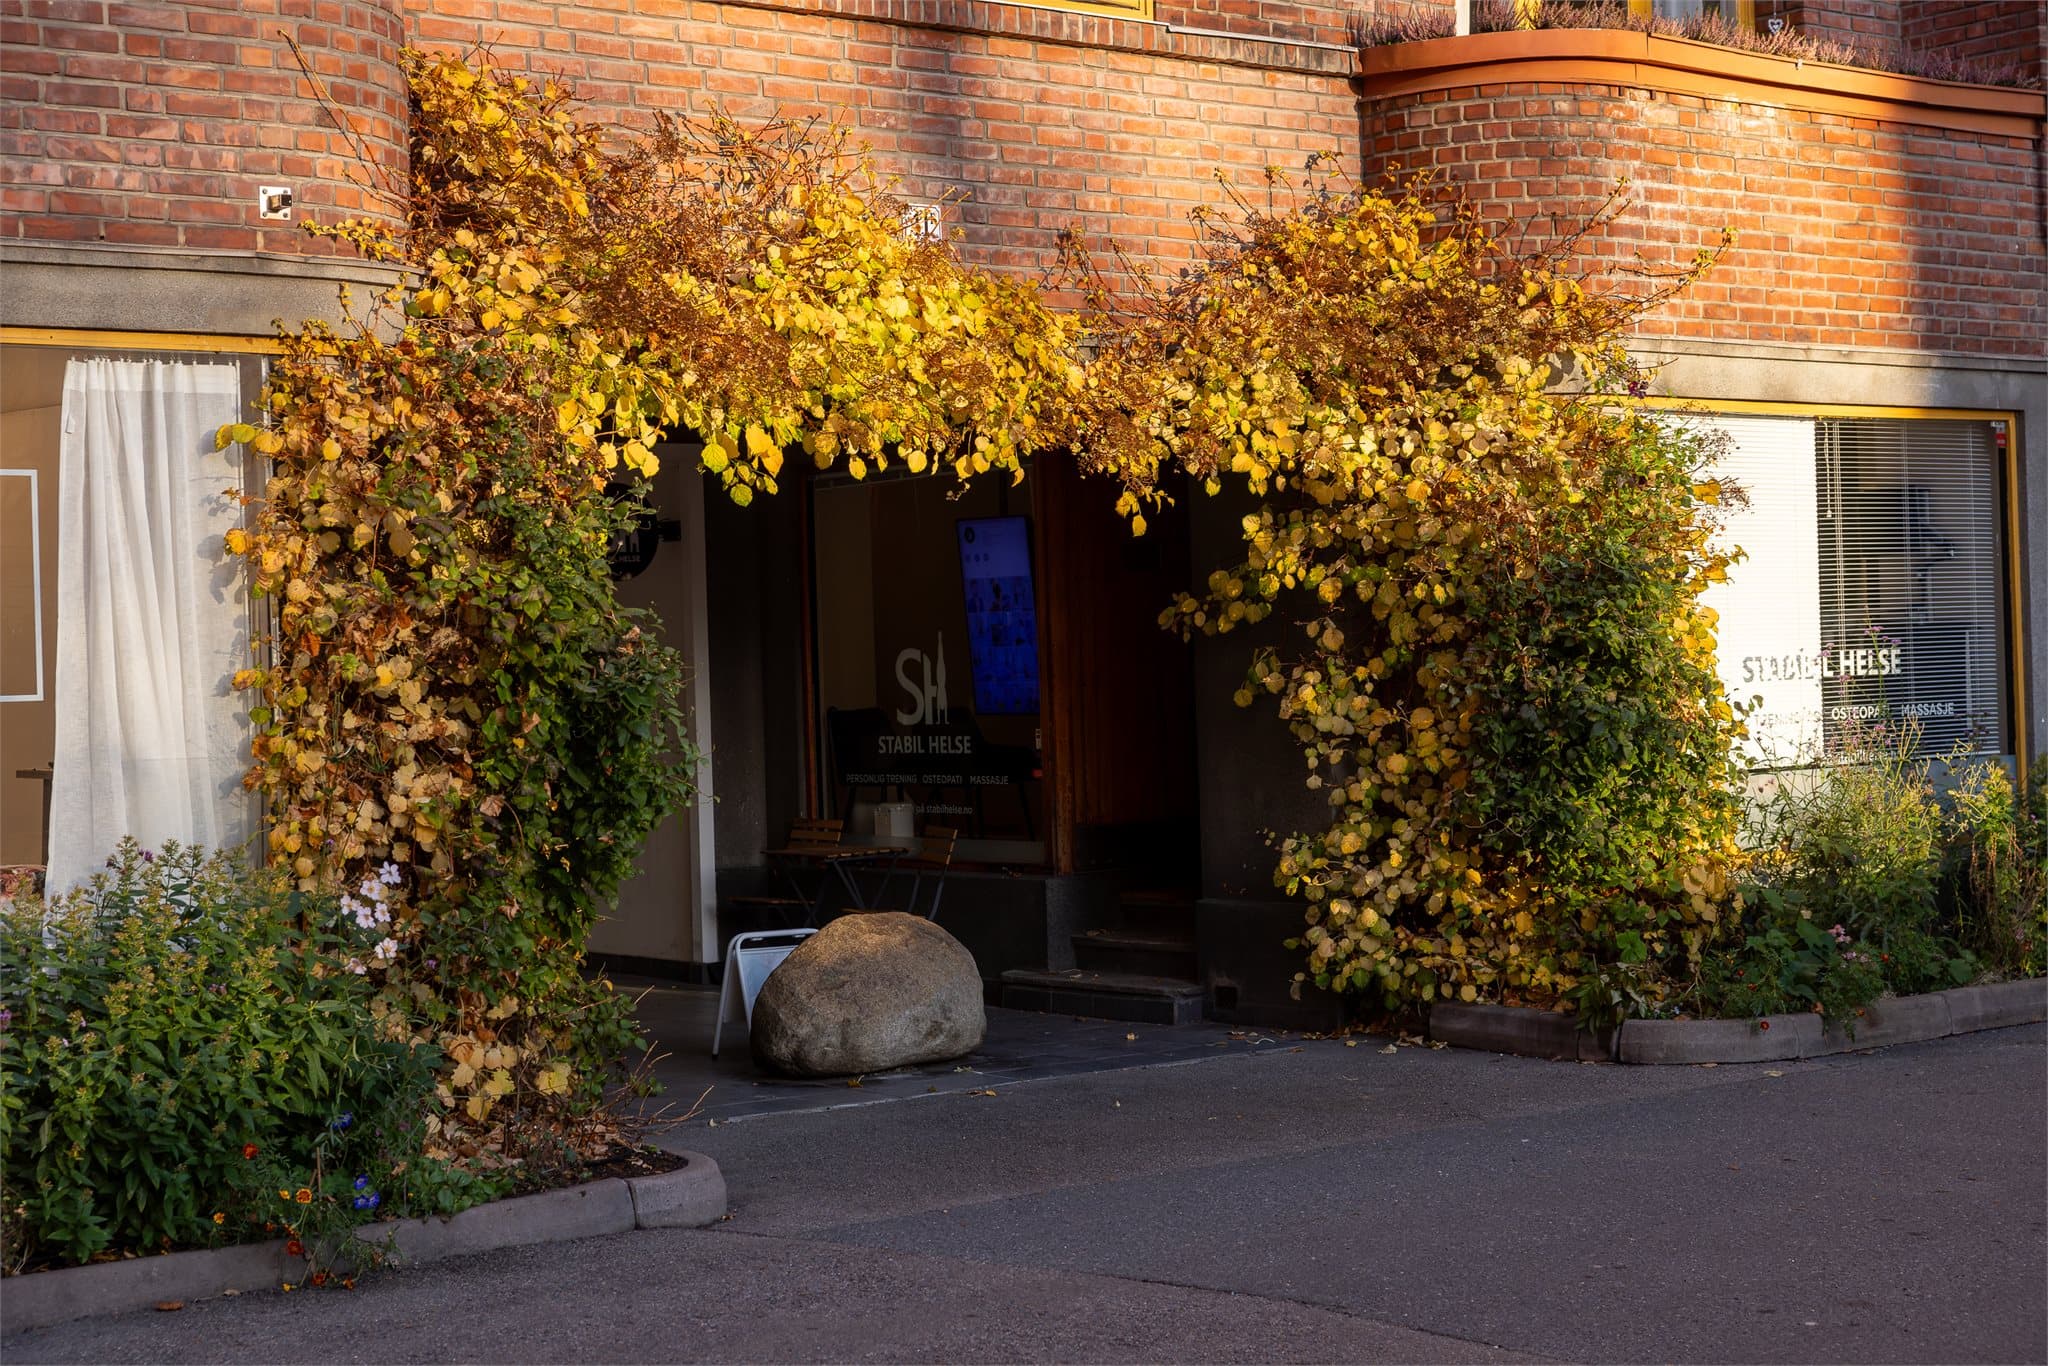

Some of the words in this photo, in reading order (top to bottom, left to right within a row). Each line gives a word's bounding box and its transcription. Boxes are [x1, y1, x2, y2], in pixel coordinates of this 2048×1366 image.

[1839, 649, 1902, 677] HELSE
[1831, 704, 1890, 720] OSTEOPA
[1901, 702, 1955, 717] MASSASJE
[878, 735, 925, 754] STABIL
[929, 735, 972, 754] HELSE
[846, 773, 885, 784] PERSONLIG
[886, 773, 917, 785] TRENING
[922, 774, 963, 785] OSTEOPATI
[970, 775, 1009, 785] MASSASJE
